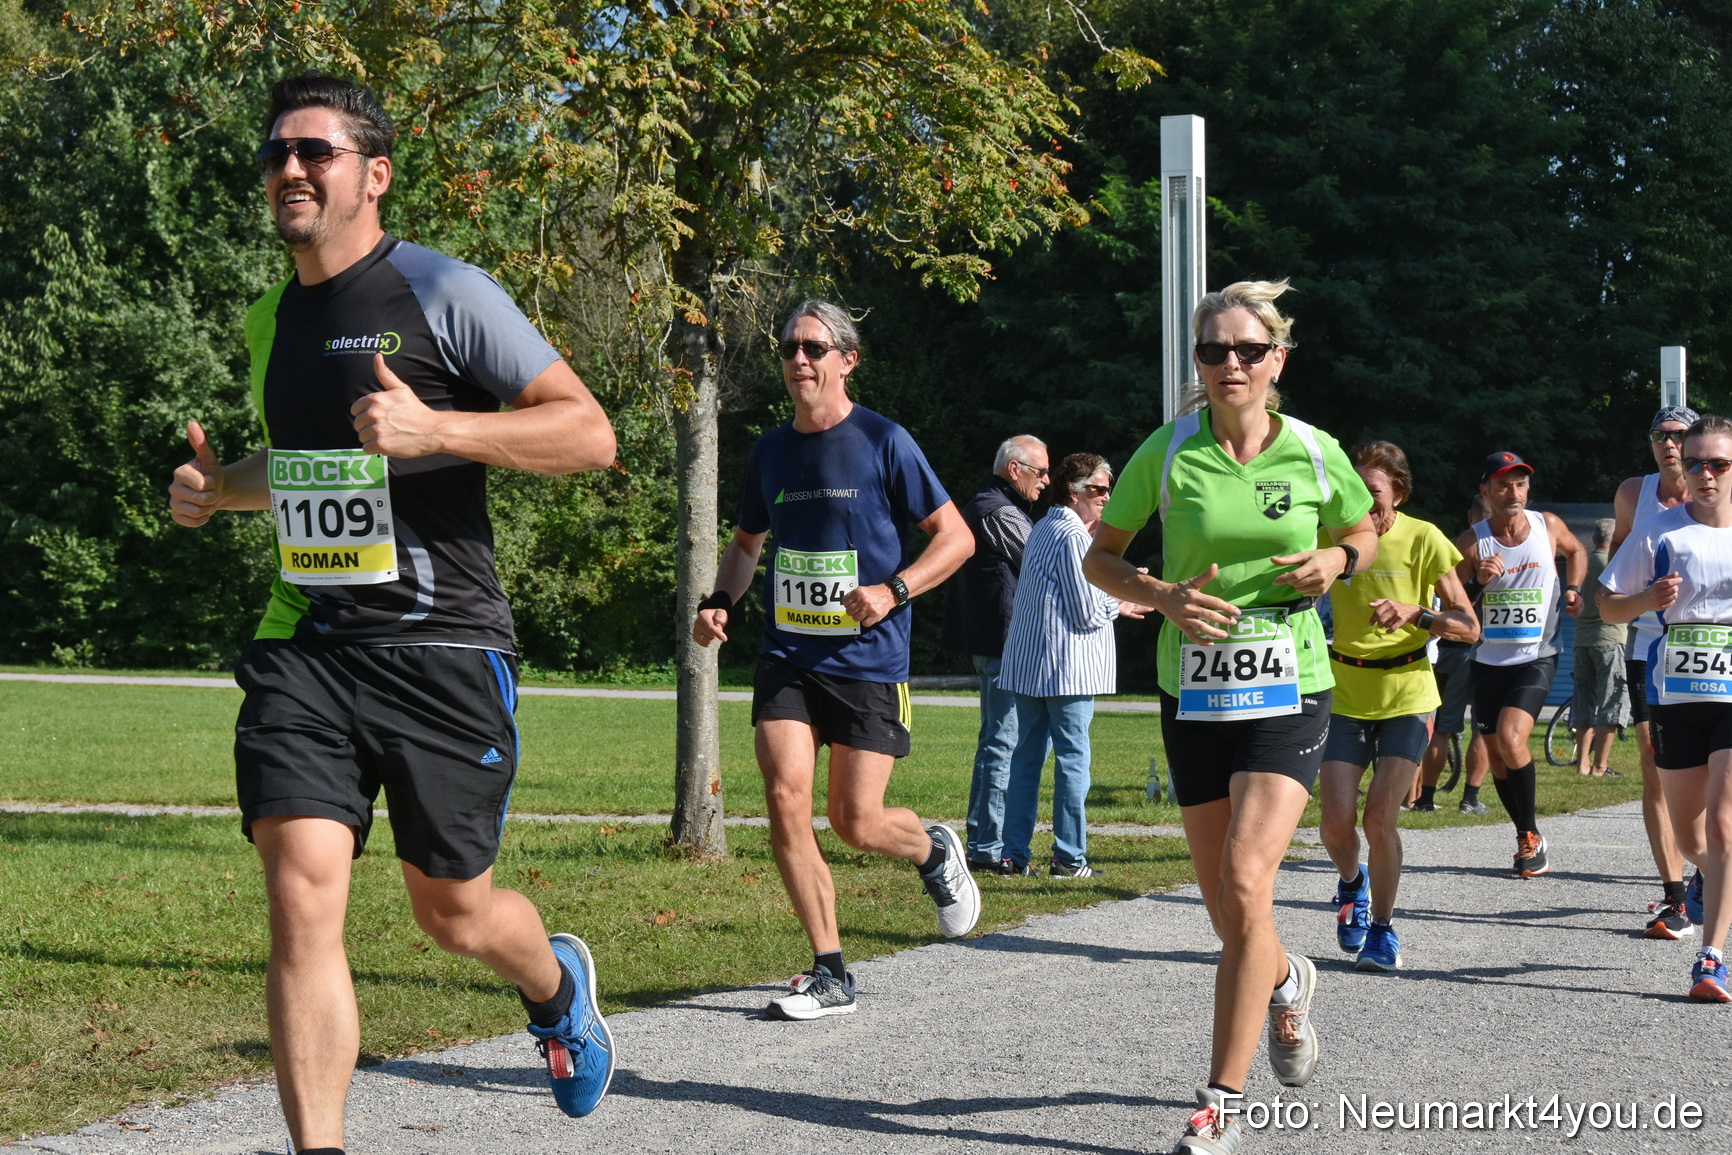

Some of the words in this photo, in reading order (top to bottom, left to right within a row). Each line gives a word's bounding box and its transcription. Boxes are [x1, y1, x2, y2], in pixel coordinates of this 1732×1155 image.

[325, 333, 391, 351] solectrix
[274, 456, 373, 485] BOCK
[784, 490, 812, 503] GOSSEN
[813, 488, 859, 499] METRAWATT
[1264, 492, 1272, 505] F
[1275, 501, 1286, 514] C
[280, 498, 374, 538] 1109
[292, 552, 359, 568] ROMAN
[779, 553, 847, 574] BOCK
[782, 579, 844, 607] 1184
[1486, 591, 1537, 604] BOCK
[787, 612, 841, 626] MARKUS
[1489, 608, 1537, 625] 2736
[1674, 628, 1732, 645] BOC
[1191, 647, 1283, 682] 2484
[1690, 681, 1727, 693] ROSA
[1207, 691, 1264, 708] HEIKE
